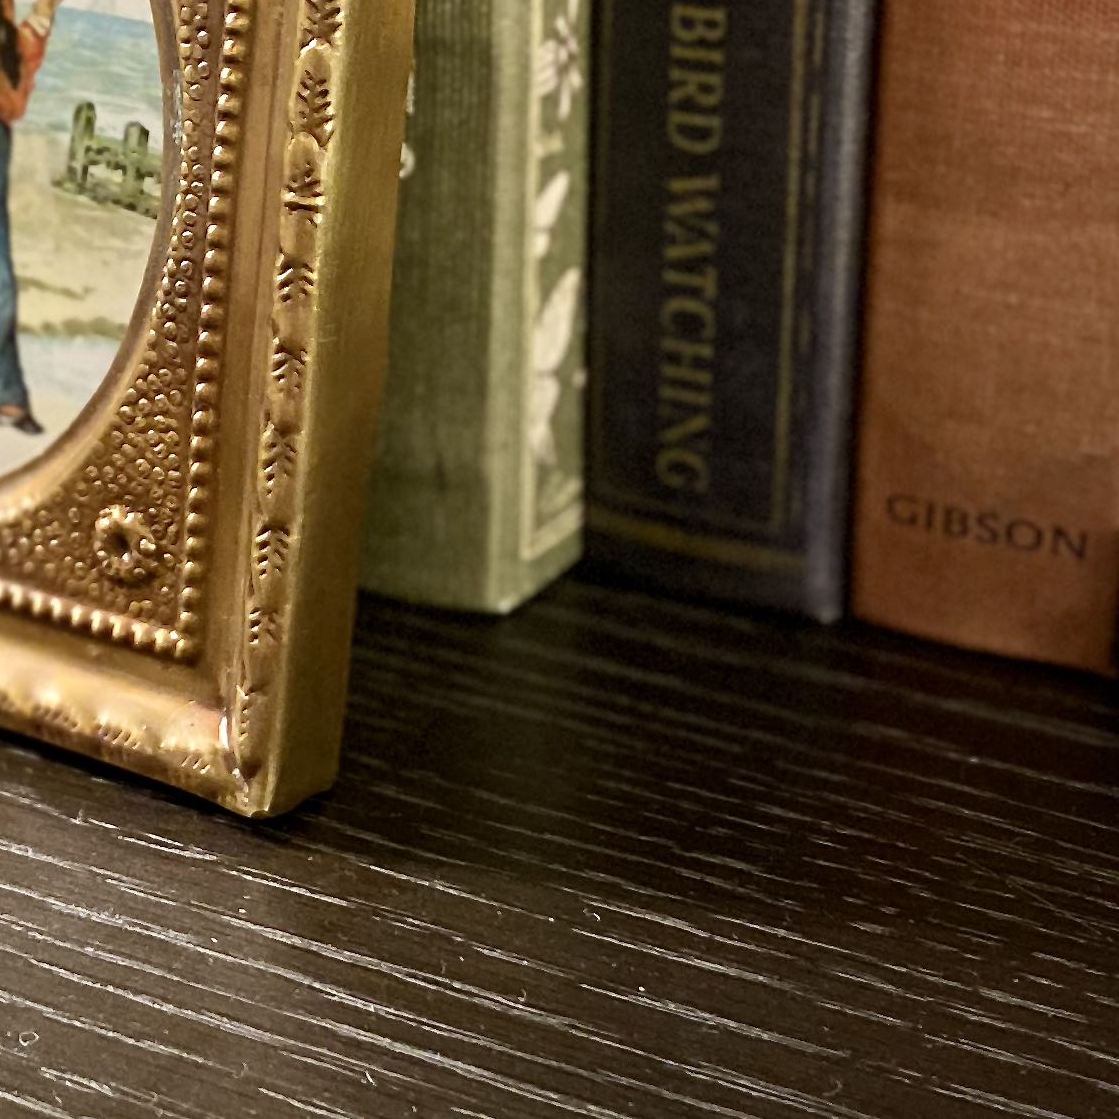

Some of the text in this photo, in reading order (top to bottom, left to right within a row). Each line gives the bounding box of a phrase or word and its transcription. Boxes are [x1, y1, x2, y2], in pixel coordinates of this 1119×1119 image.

[667, 1, 730, 155] BIRD
[655, 170, 722, 493] WATCHING
[886, 491, 1090, 561] GIBSON
